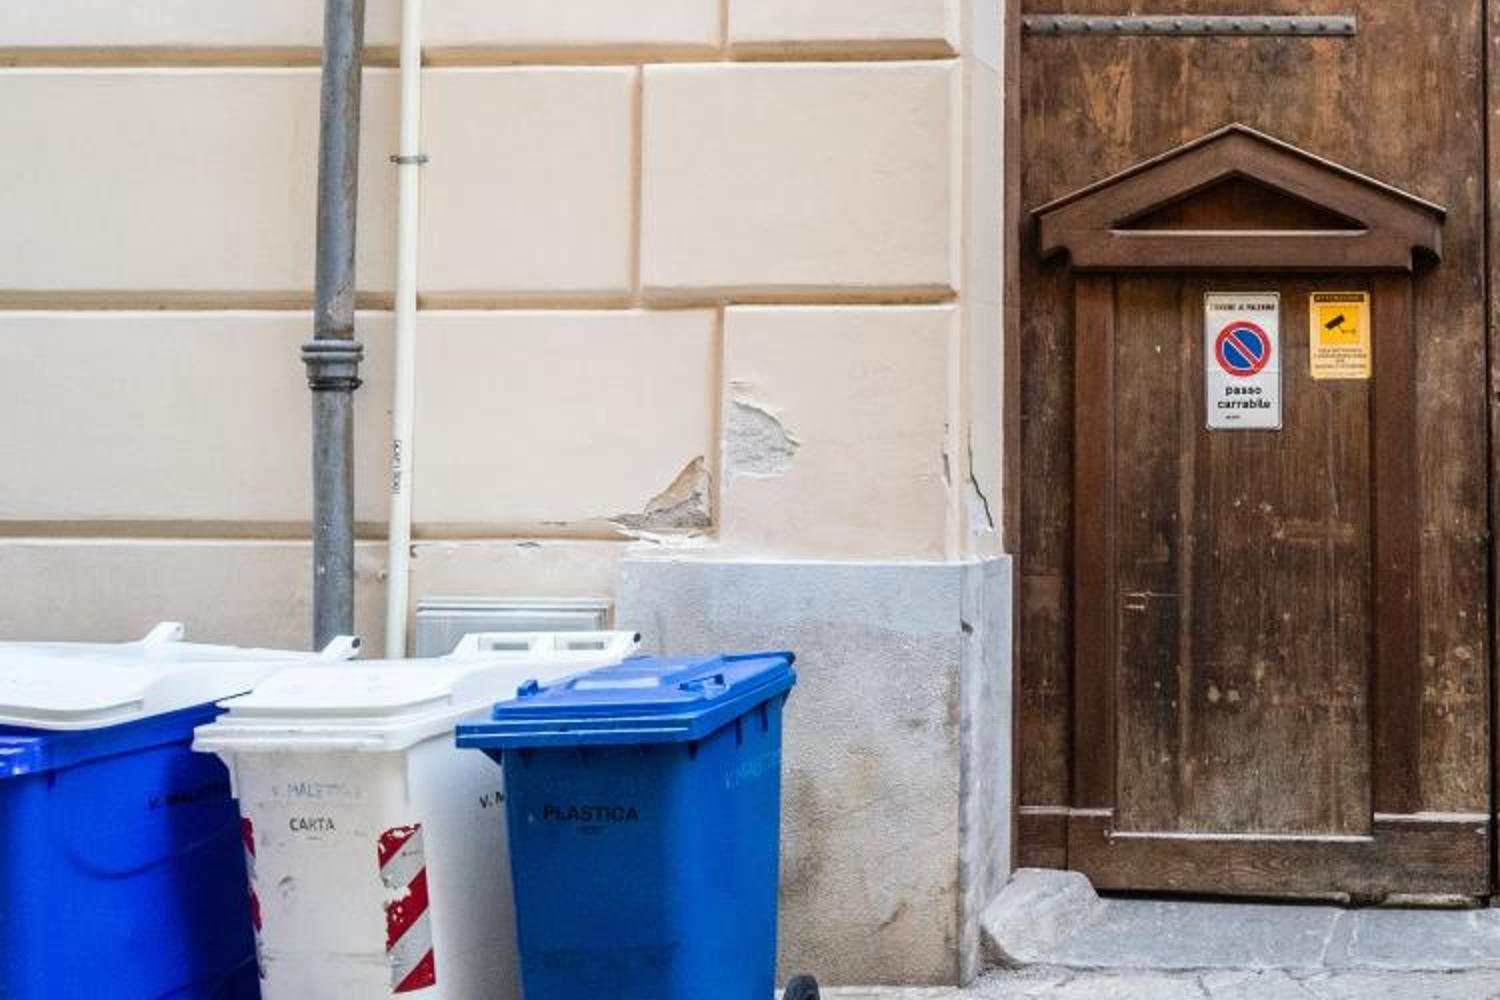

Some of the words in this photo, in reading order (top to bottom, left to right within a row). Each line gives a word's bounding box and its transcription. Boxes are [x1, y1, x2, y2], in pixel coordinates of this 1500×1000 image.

[1225, 386, 1262, 396] passo
[1217, 399, 1271, 409] carrabile
[543, 803, 640, 822] PLASTICA
[289, 817, 337, 831] CARTA
